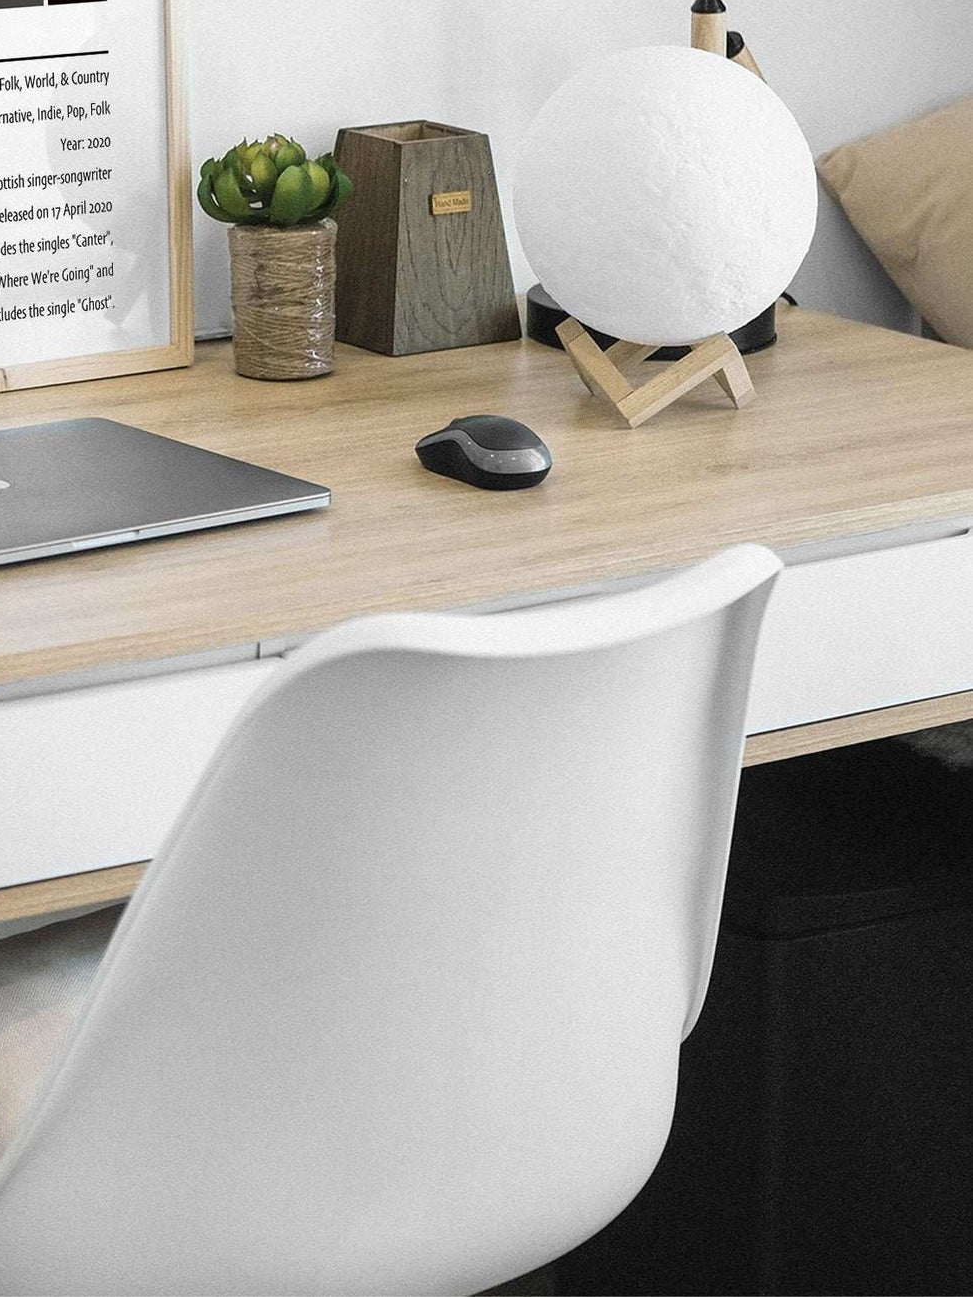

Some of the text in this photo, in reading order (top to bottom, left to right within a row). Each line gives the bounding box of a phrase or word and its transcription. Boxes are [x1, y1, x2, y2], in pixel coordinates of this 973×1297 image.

[0, 75, 22, 92] Folk,
[24, 72, 58, 89] World,
[61, 72, 69, 86] &
[71, 70, 109, 86] Country
[38, 106, 64, 121] Indie,
[67, 105, 88, 121] Pop,
[91, 101, 111, 116] Folk
[60, 137, 111, 151] Year: 2020
[27, 167, 112, 190] singer-songwriter
[37, 208, 48, 219] on
[51, 207, 61, 220] 17
[63, 200, 86, 220] April
[89, 202, 112, 213] 2020
[19, 239, 35, 254] the
[37, 236, 70, 254] singles
[72, 231, 113, 247] "Canter",
[31, 270, 59, 285] We're
[62, 265, 93, 283] Going"
[97, 262, 113, 277] and
[29, 304, 45, 318] the
[47, 300, 75, 318] single
[78, 295, 115, 311] "Ghost".
